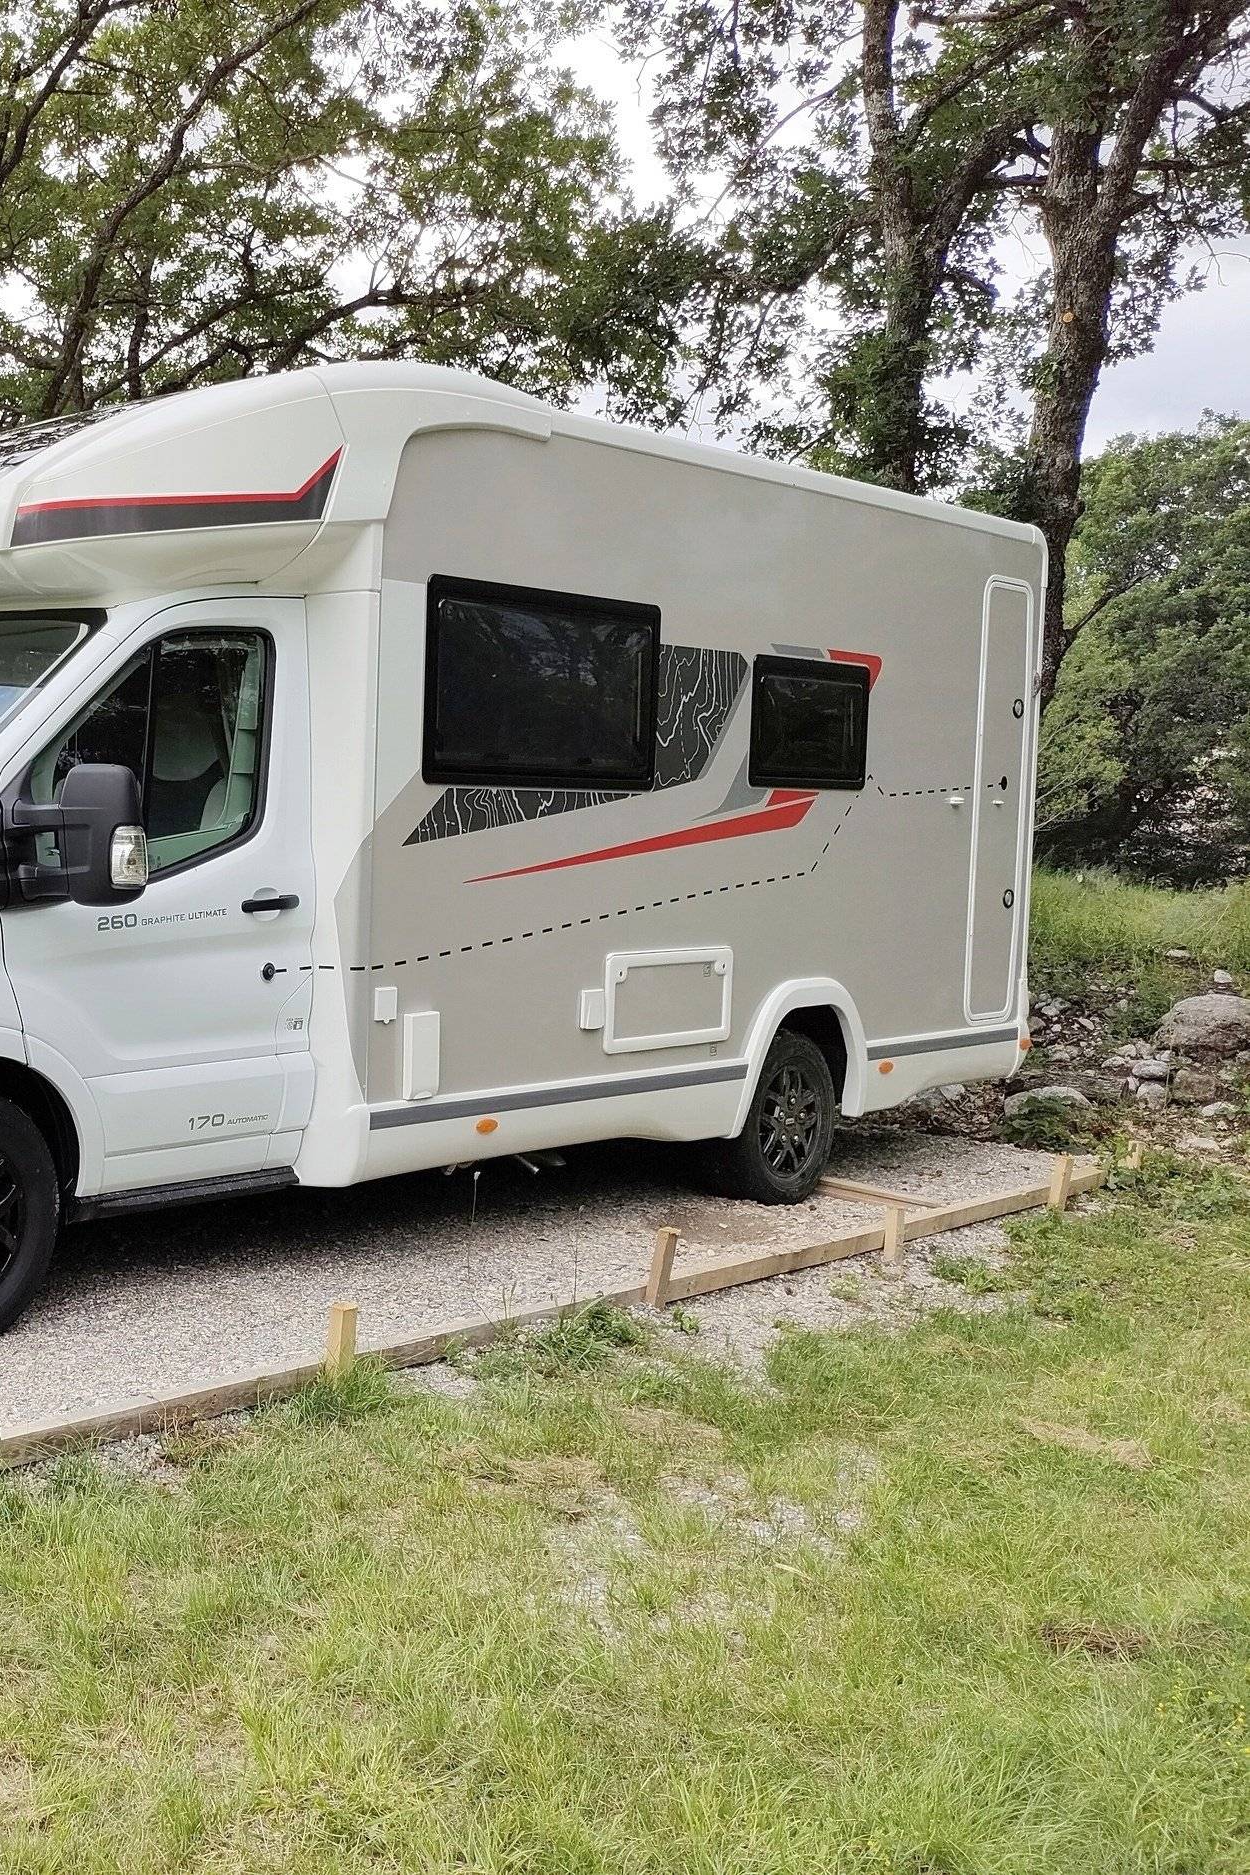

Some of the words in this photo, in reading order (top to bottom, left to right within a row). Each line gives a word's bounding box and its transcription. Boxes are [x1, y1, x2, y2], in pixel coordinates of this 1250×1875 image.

[97, 913, 138, 931] 260
[141, 913, 186, 926] GRAPHITE
[188, 908, 228, 920] ULTIMATE
[188, 1113, 225, 1130] 170
[227, 1114, 269, 1125] AUTOMATIC
